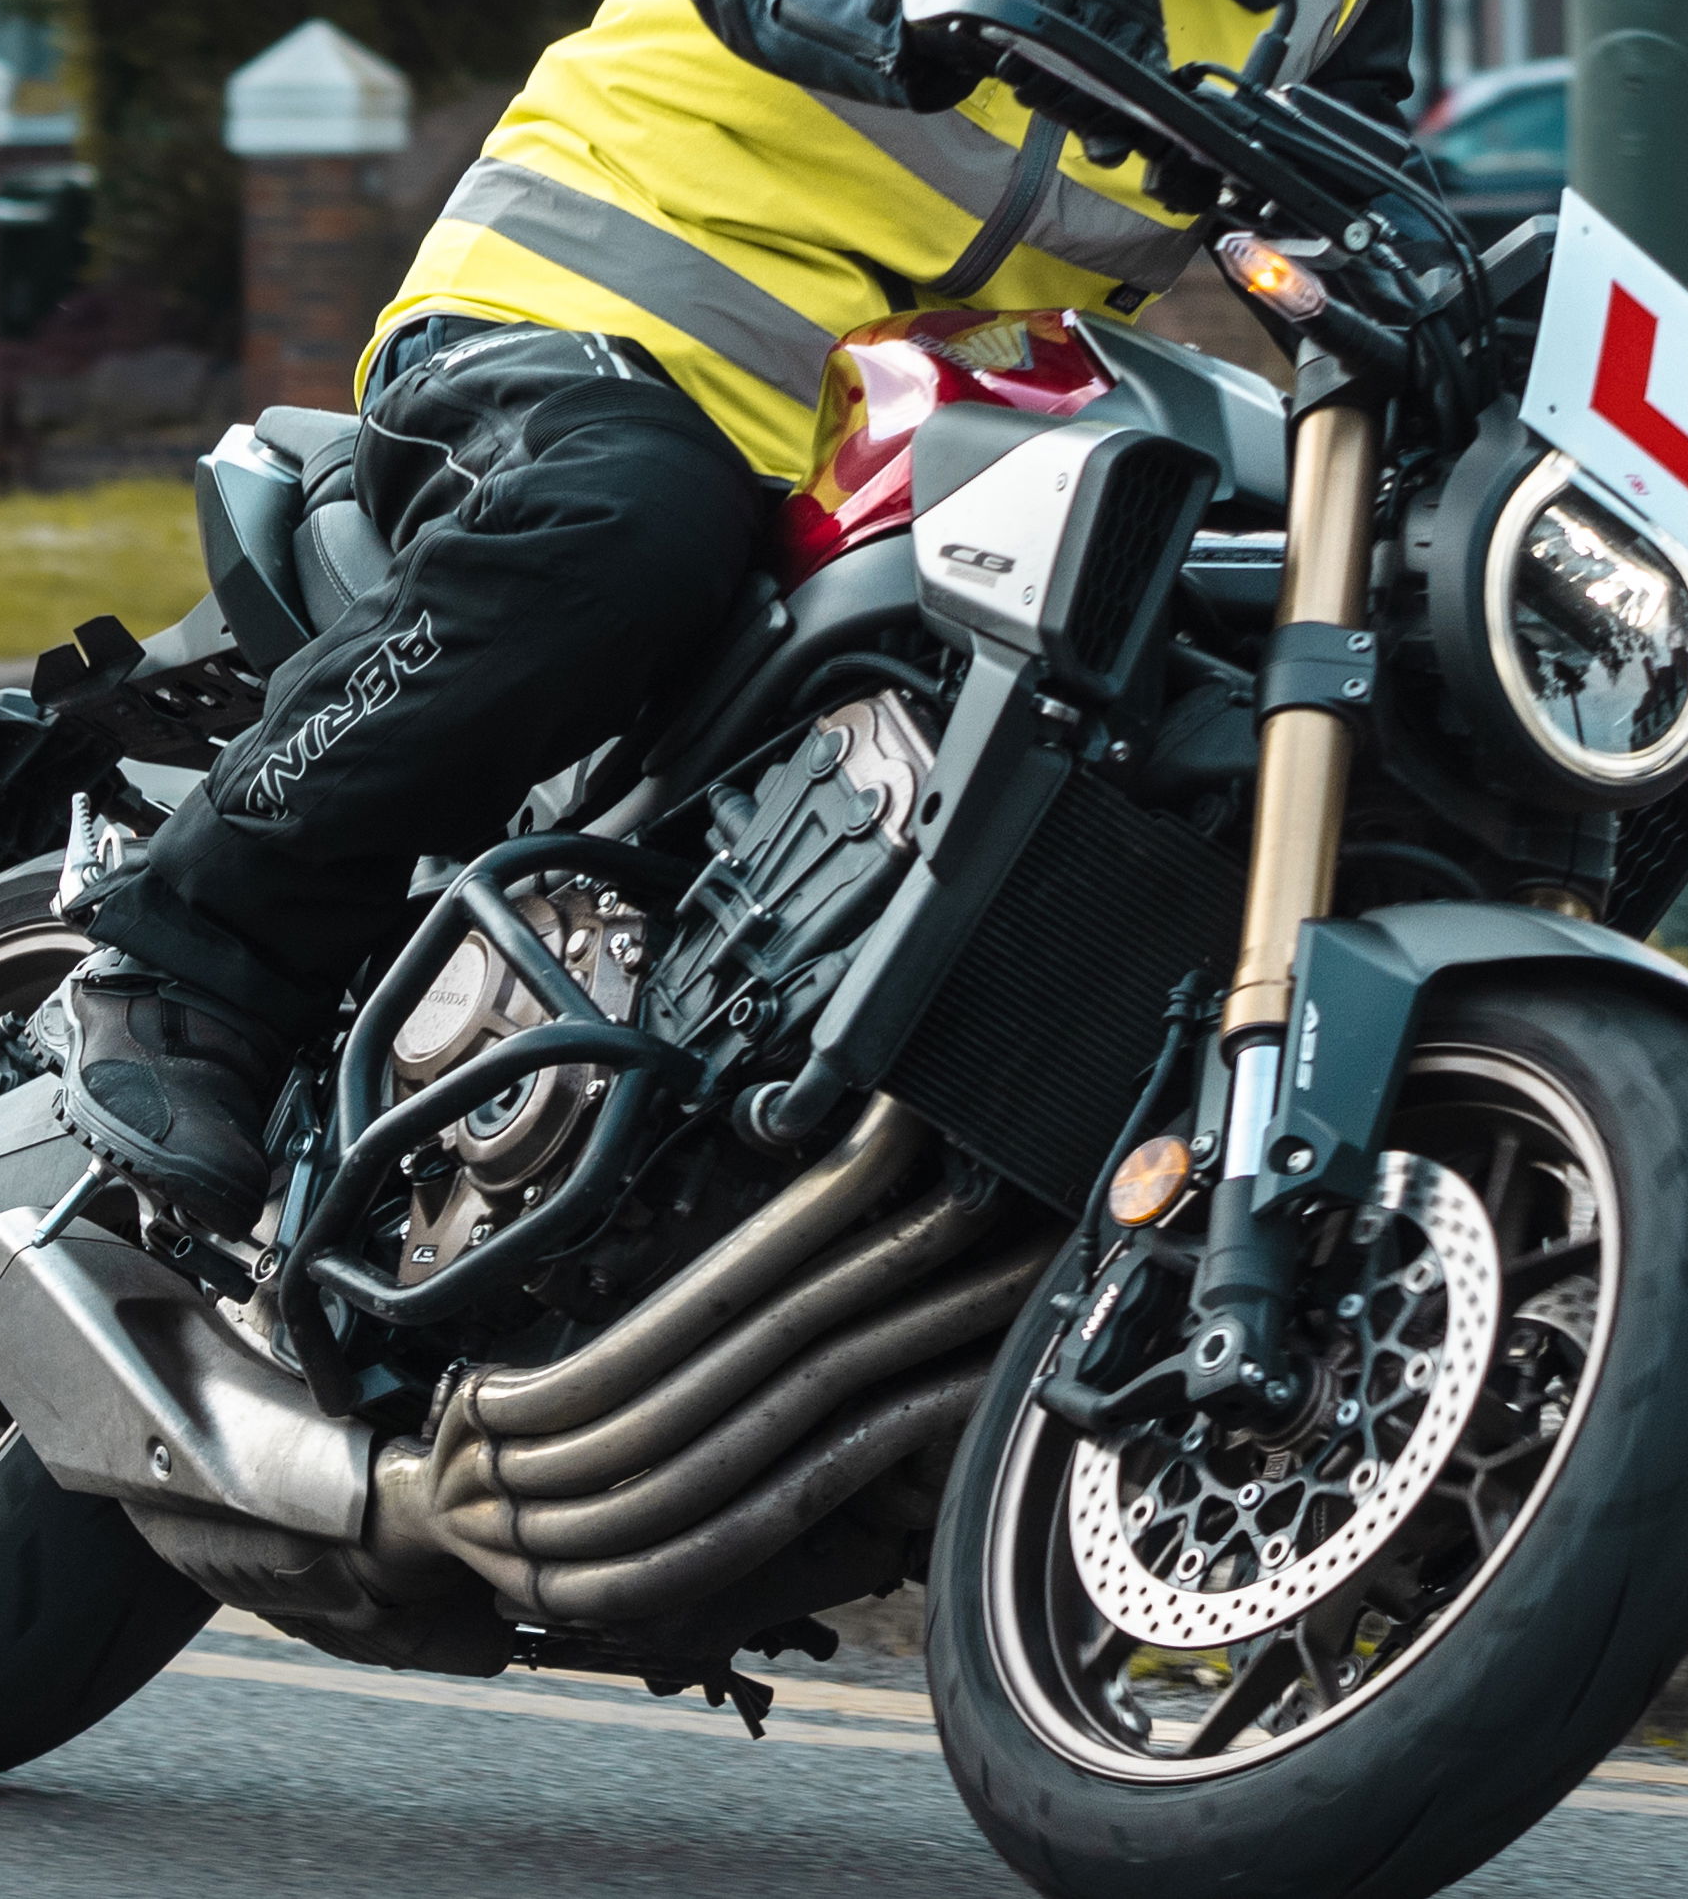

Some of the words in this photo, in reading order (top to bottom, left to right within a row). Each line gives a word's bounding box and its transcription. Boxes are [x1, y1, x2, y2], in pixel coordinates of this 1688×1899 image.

[939, 544, 1015, 573] CB
[246, 610, 442, 821] BERING
[425, 989, 470, 1007] ONDA
[1296, 999, 1319, 1091] ABS
